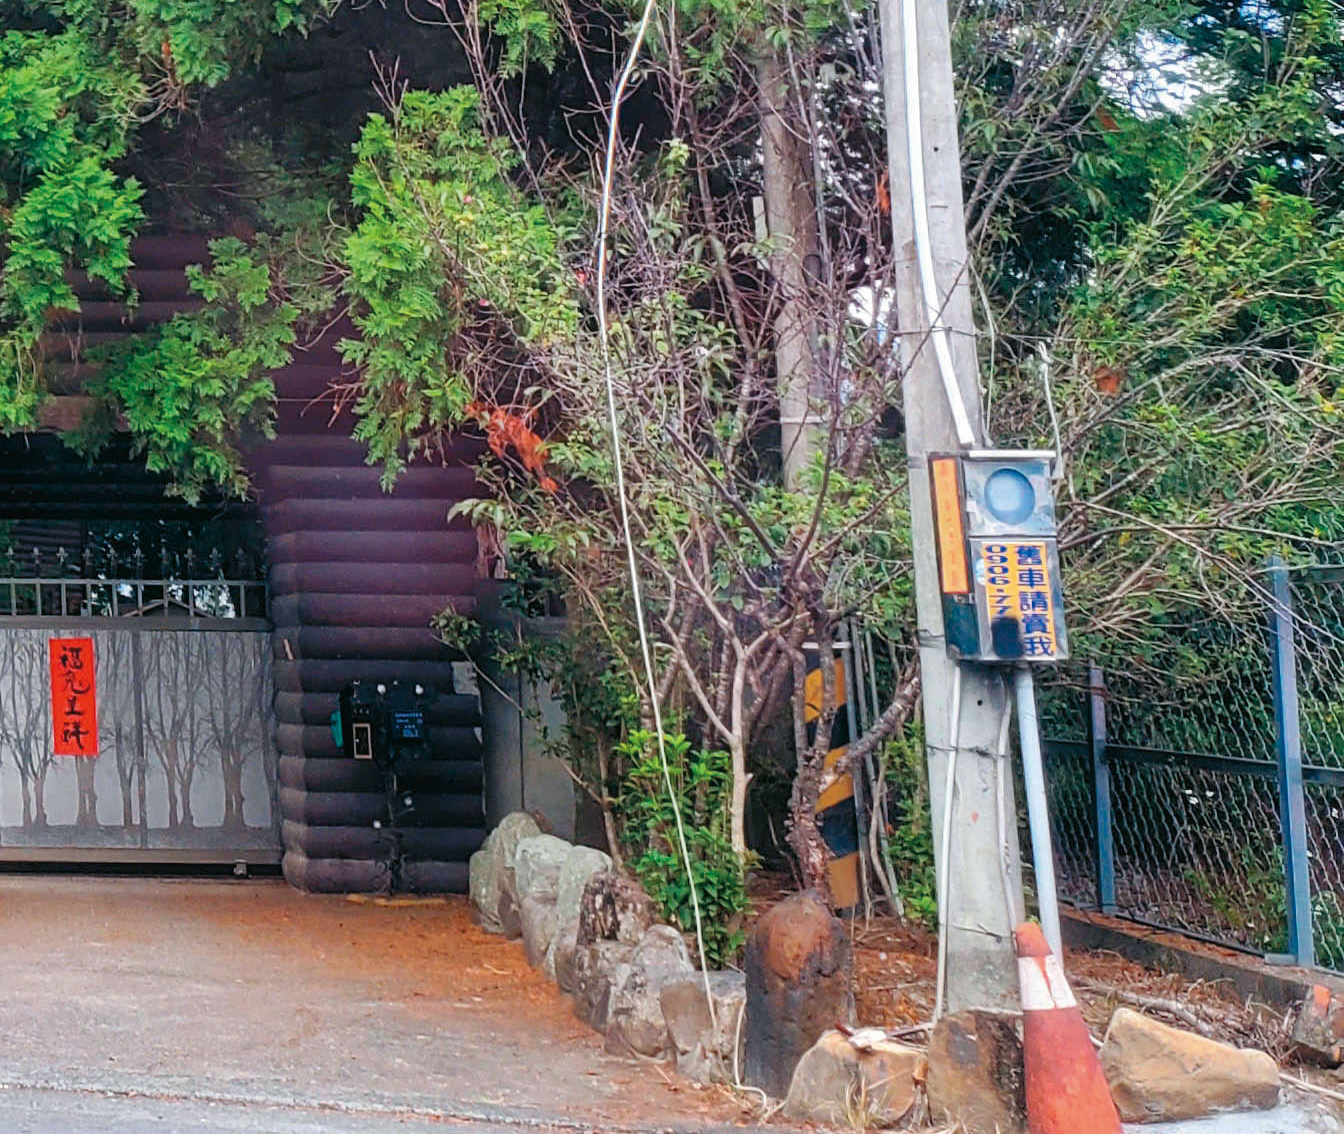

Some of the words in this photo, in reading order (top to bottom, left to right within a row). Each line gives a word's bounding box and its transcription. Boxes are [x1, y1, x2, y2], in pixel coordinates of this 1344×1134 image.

[1014, 545, 1053, 656] 舊車請賣我
